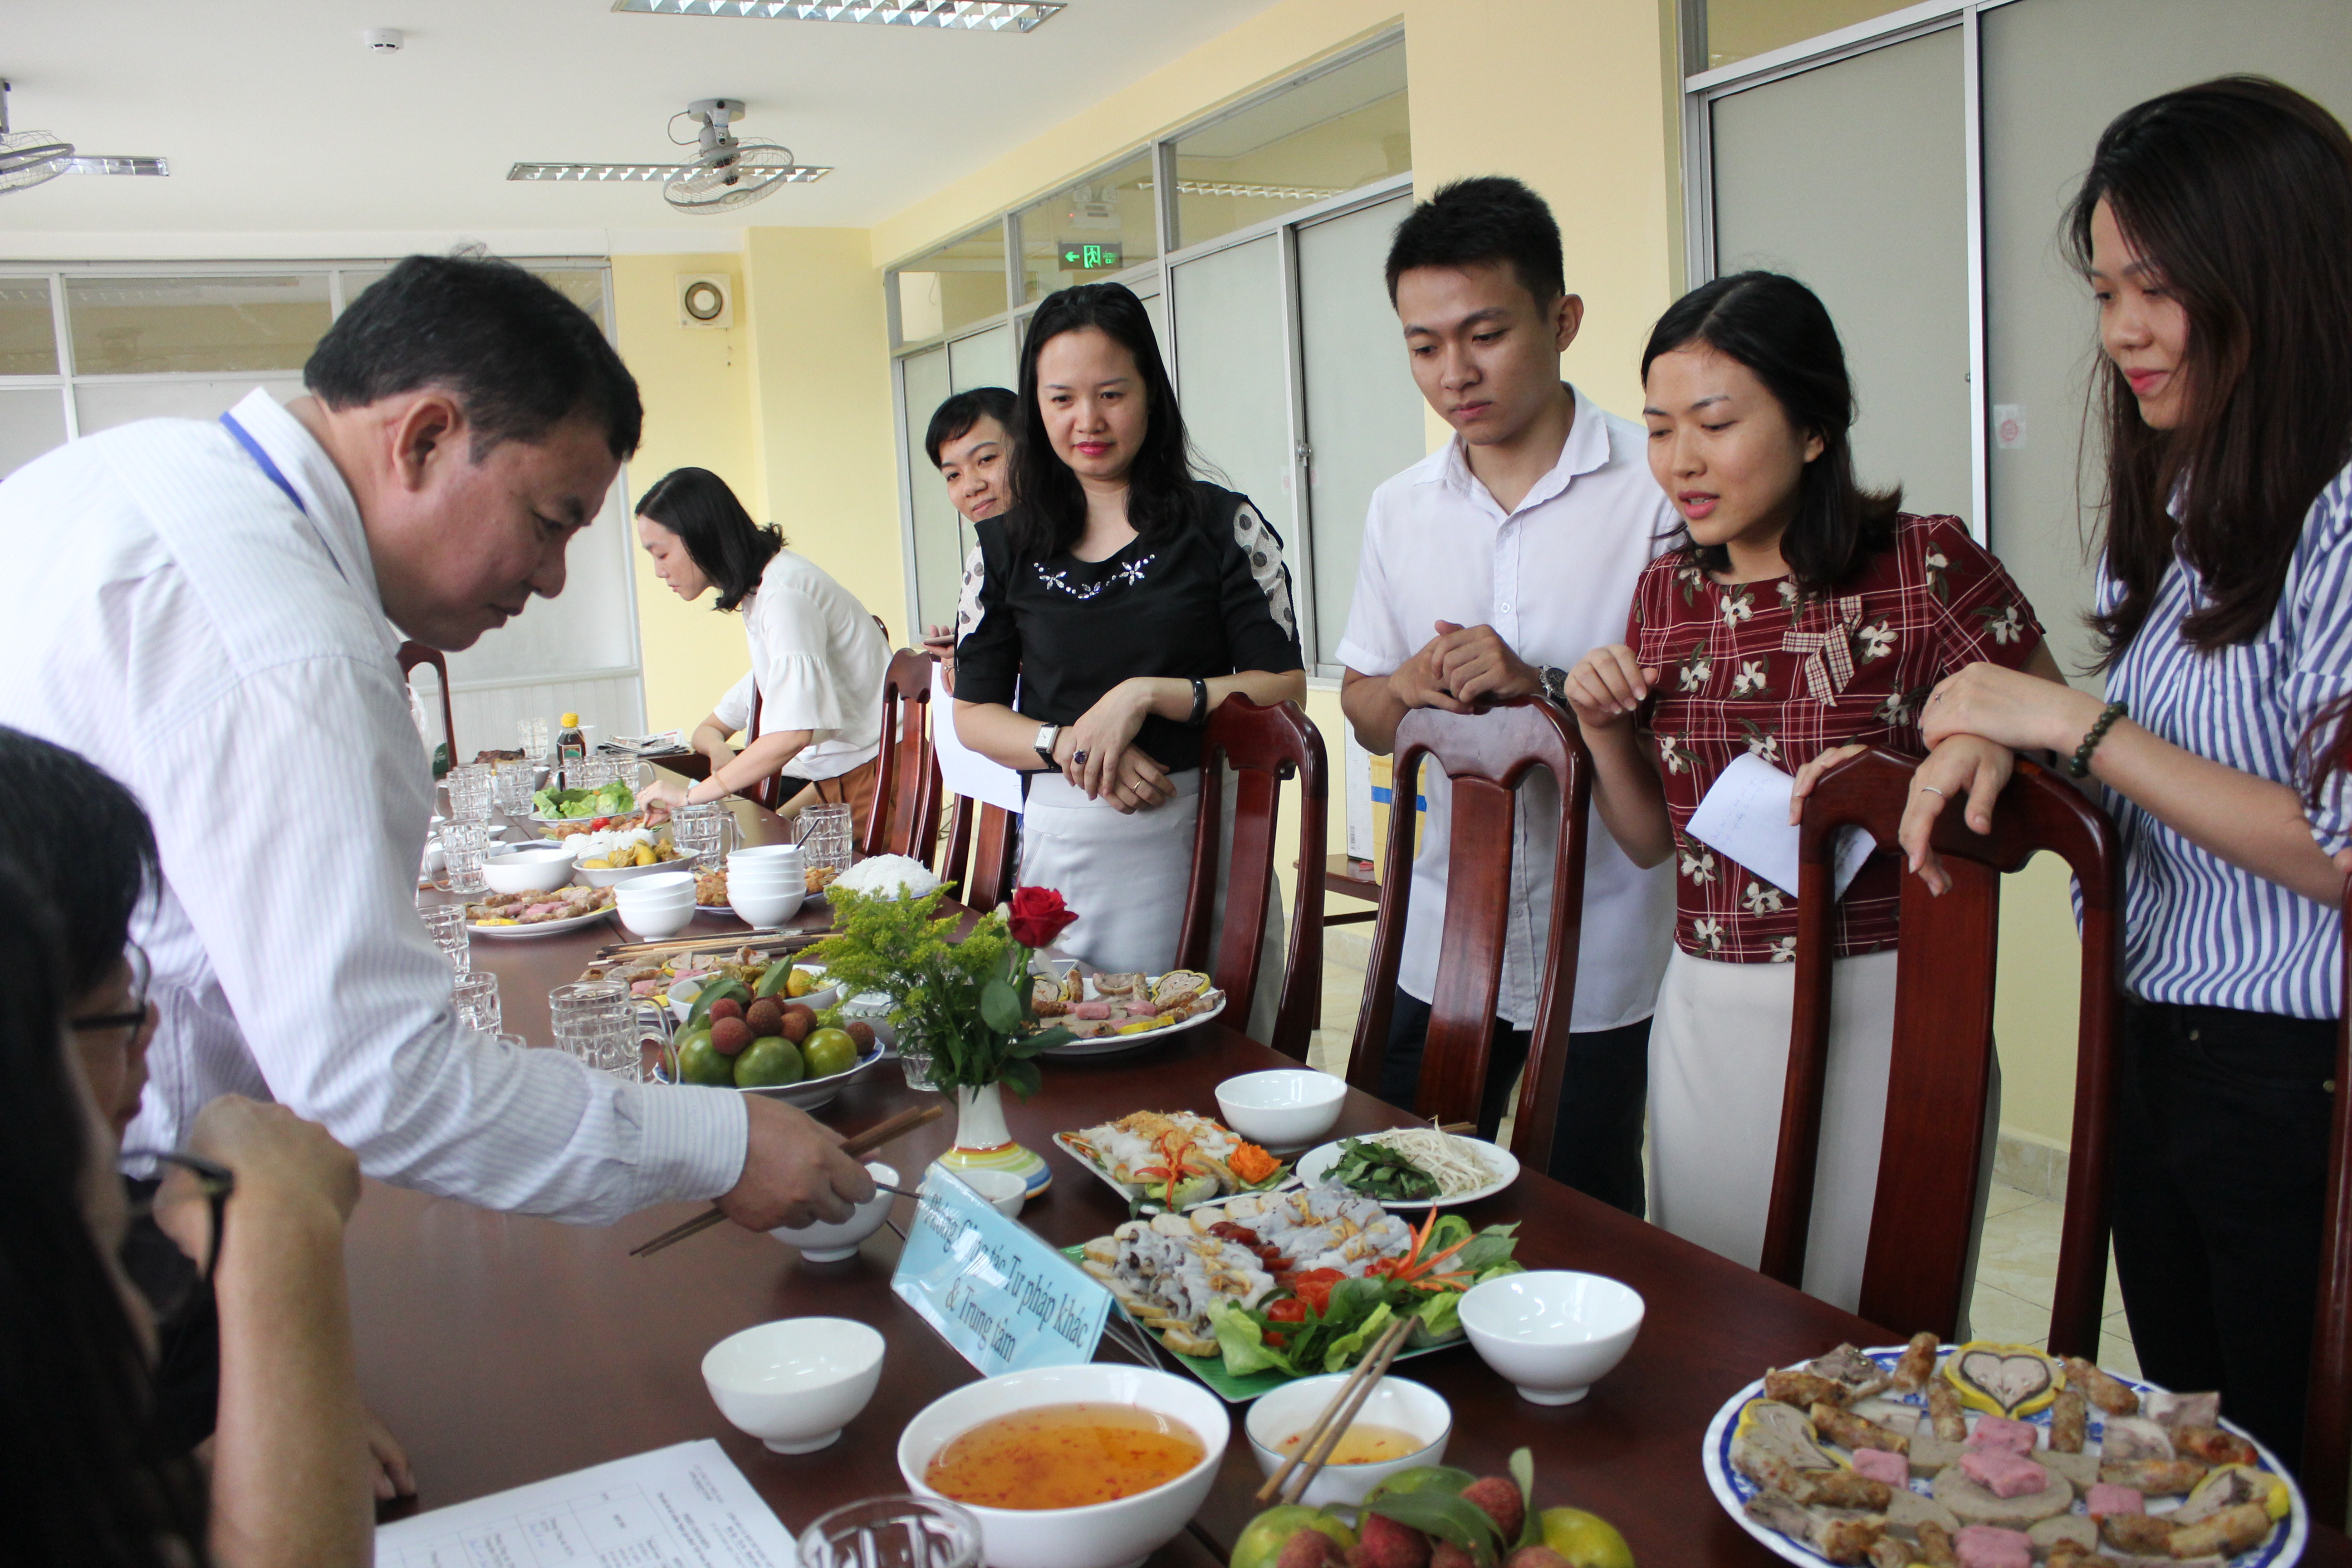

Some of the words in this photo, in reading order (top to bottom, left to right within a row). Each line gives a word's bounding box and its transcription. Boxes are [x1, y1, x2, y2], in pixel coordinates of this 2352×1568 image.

[946, 1277, 960, 1312] &
[958, 1285, 993, 1351] Trung
[991, 1318, 1015, 1363] tâm
[1003, 1255, 1025, 1298] Tư
[1016, 1274, 1055, 1332] pháp
[1053, 1294, 1088, 1349] khác
